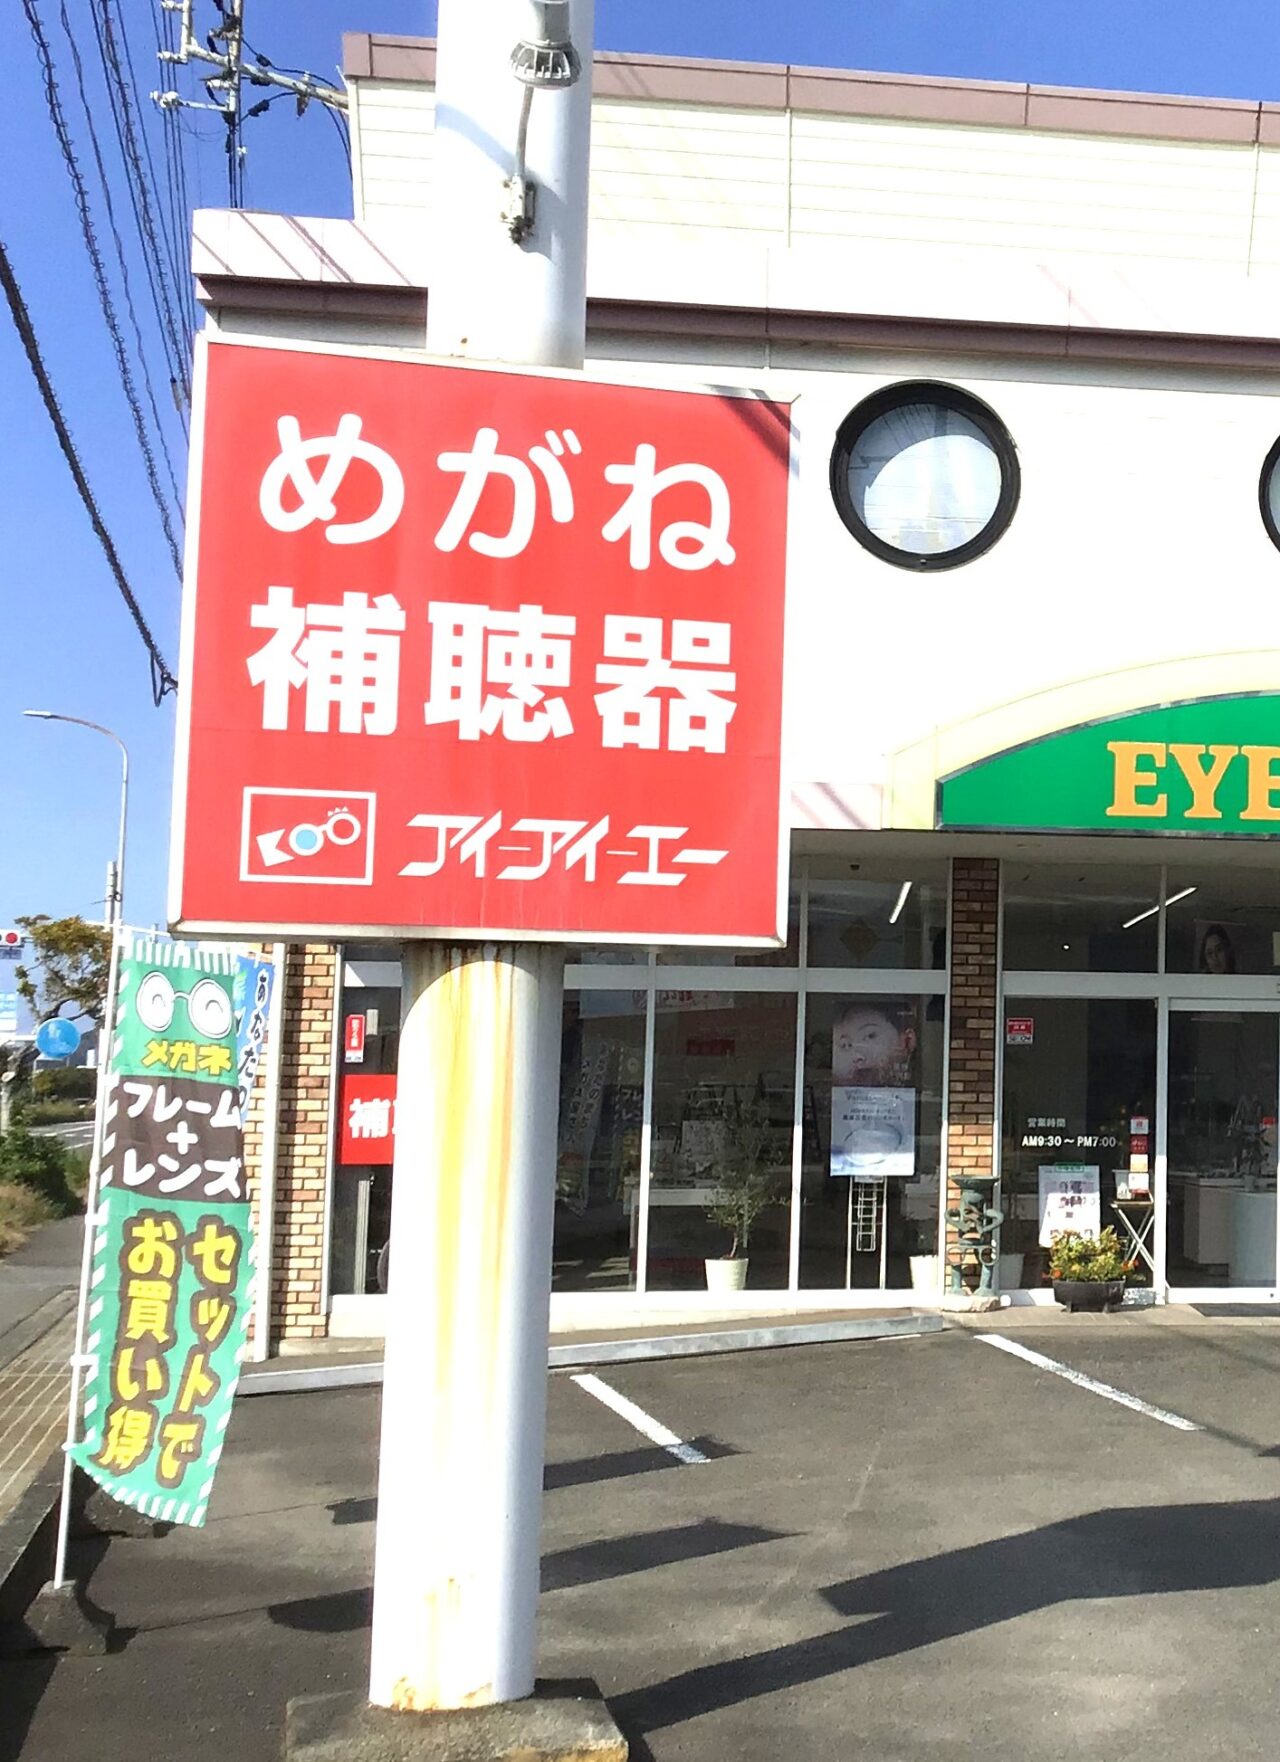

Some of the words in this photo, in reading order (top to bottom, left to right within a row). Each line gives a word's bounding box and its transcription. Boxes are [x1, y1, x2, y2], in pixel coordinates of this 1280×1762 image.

[259, 413, 737, 571] めがね
[245, 585, 738, 755] 補聴器
[123, 1081, 241, 1130] フレーム
[141, 1041, 233, 1076] メガネ
[123, 1148, 241, 1199] レンズ
[98, 1218, 178, 1470] お買い得
[158, 1225, 237, 1479] セットで
